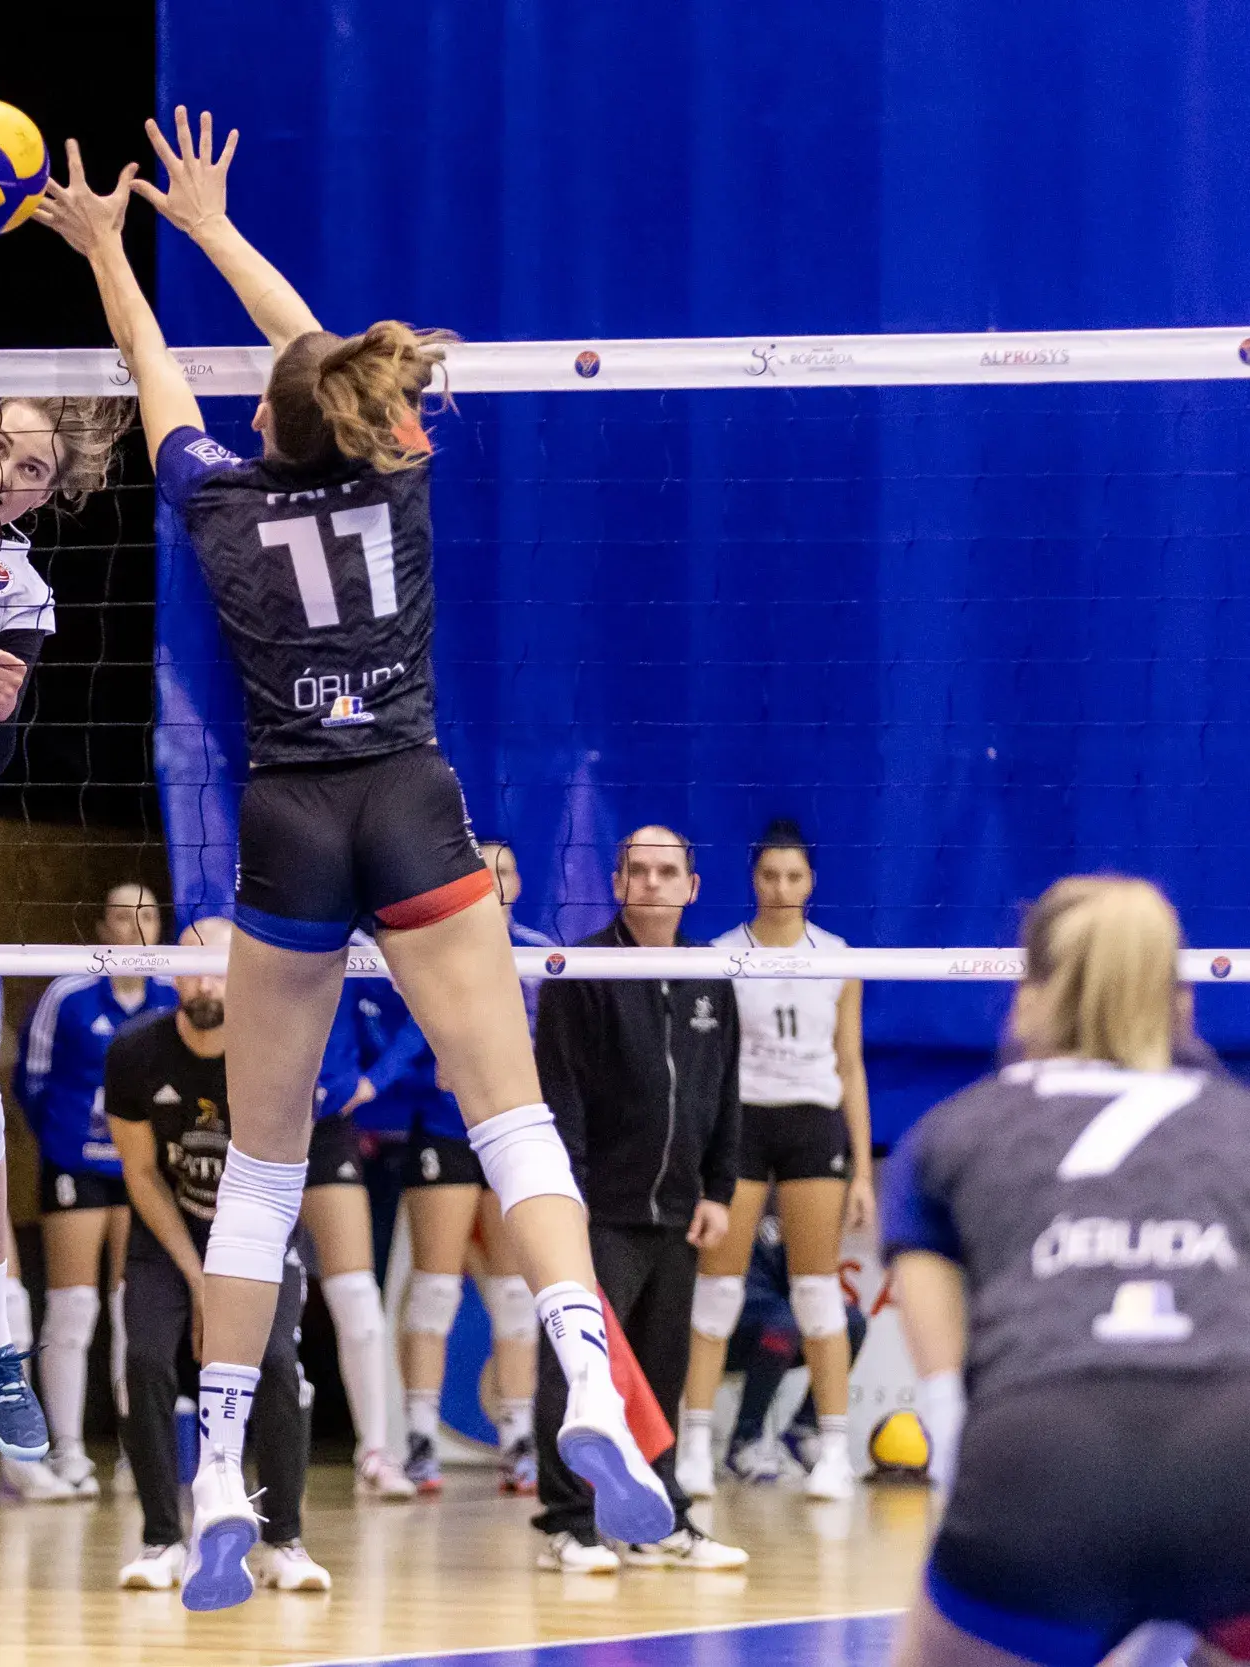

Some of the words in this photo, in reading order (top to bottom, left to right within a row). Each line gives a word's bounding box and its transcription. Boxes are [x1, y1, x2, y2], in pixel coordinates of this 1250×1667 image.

[980, 348, 1070, 366] ALPROSYS
[257, 502, 398, 628] 11
[948, 960, 1027, 974] ALPROSY
[773, 1003, 797, 1039] 11
[1034, 1068, 1205, 1181] 7
[550, 1308, 567, 1340] nine
[221, 1387, 239, 1420] nine
